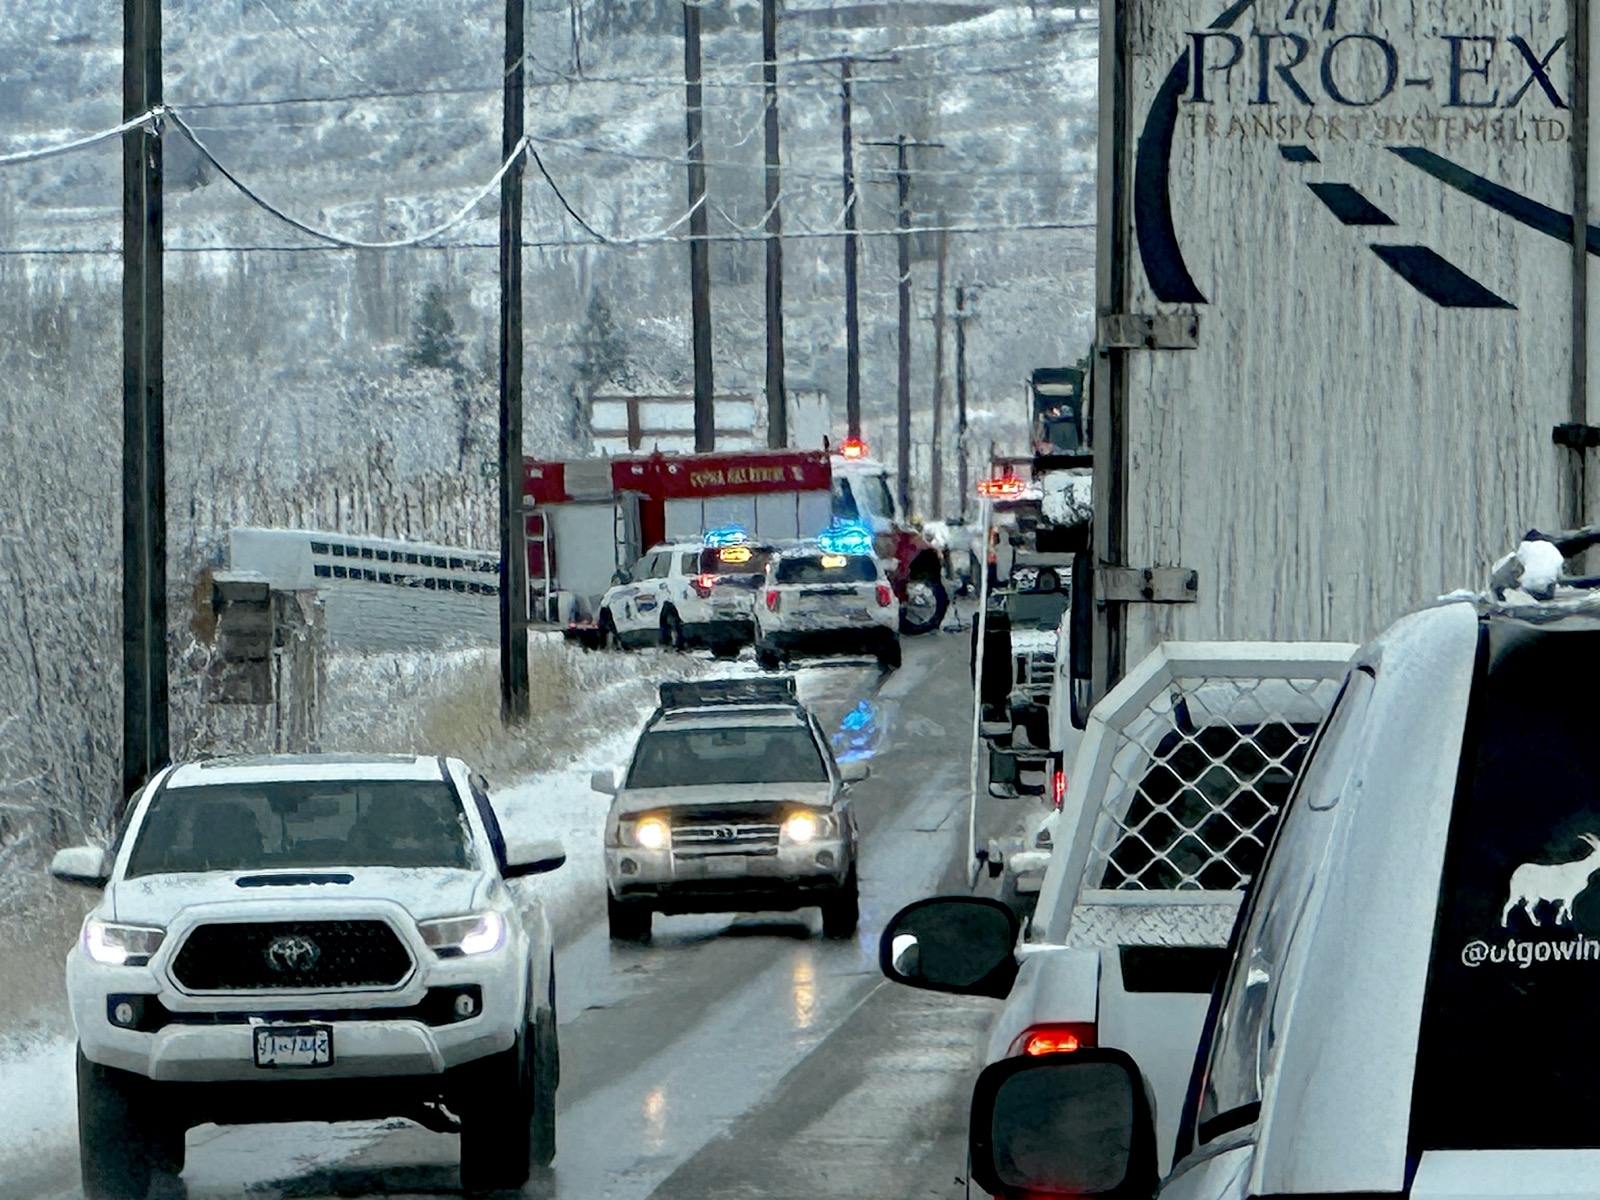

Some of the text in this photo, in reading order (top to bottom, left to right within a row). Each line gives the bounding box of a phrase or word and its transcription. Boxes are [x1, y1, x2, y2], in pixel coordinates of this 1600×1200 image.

[1182, 31, 1569, 110] PRO-EX
[1187, 113, 1361, 143] TRANSPORT
[1374, 114, 1505, 143] SYSTEMS
